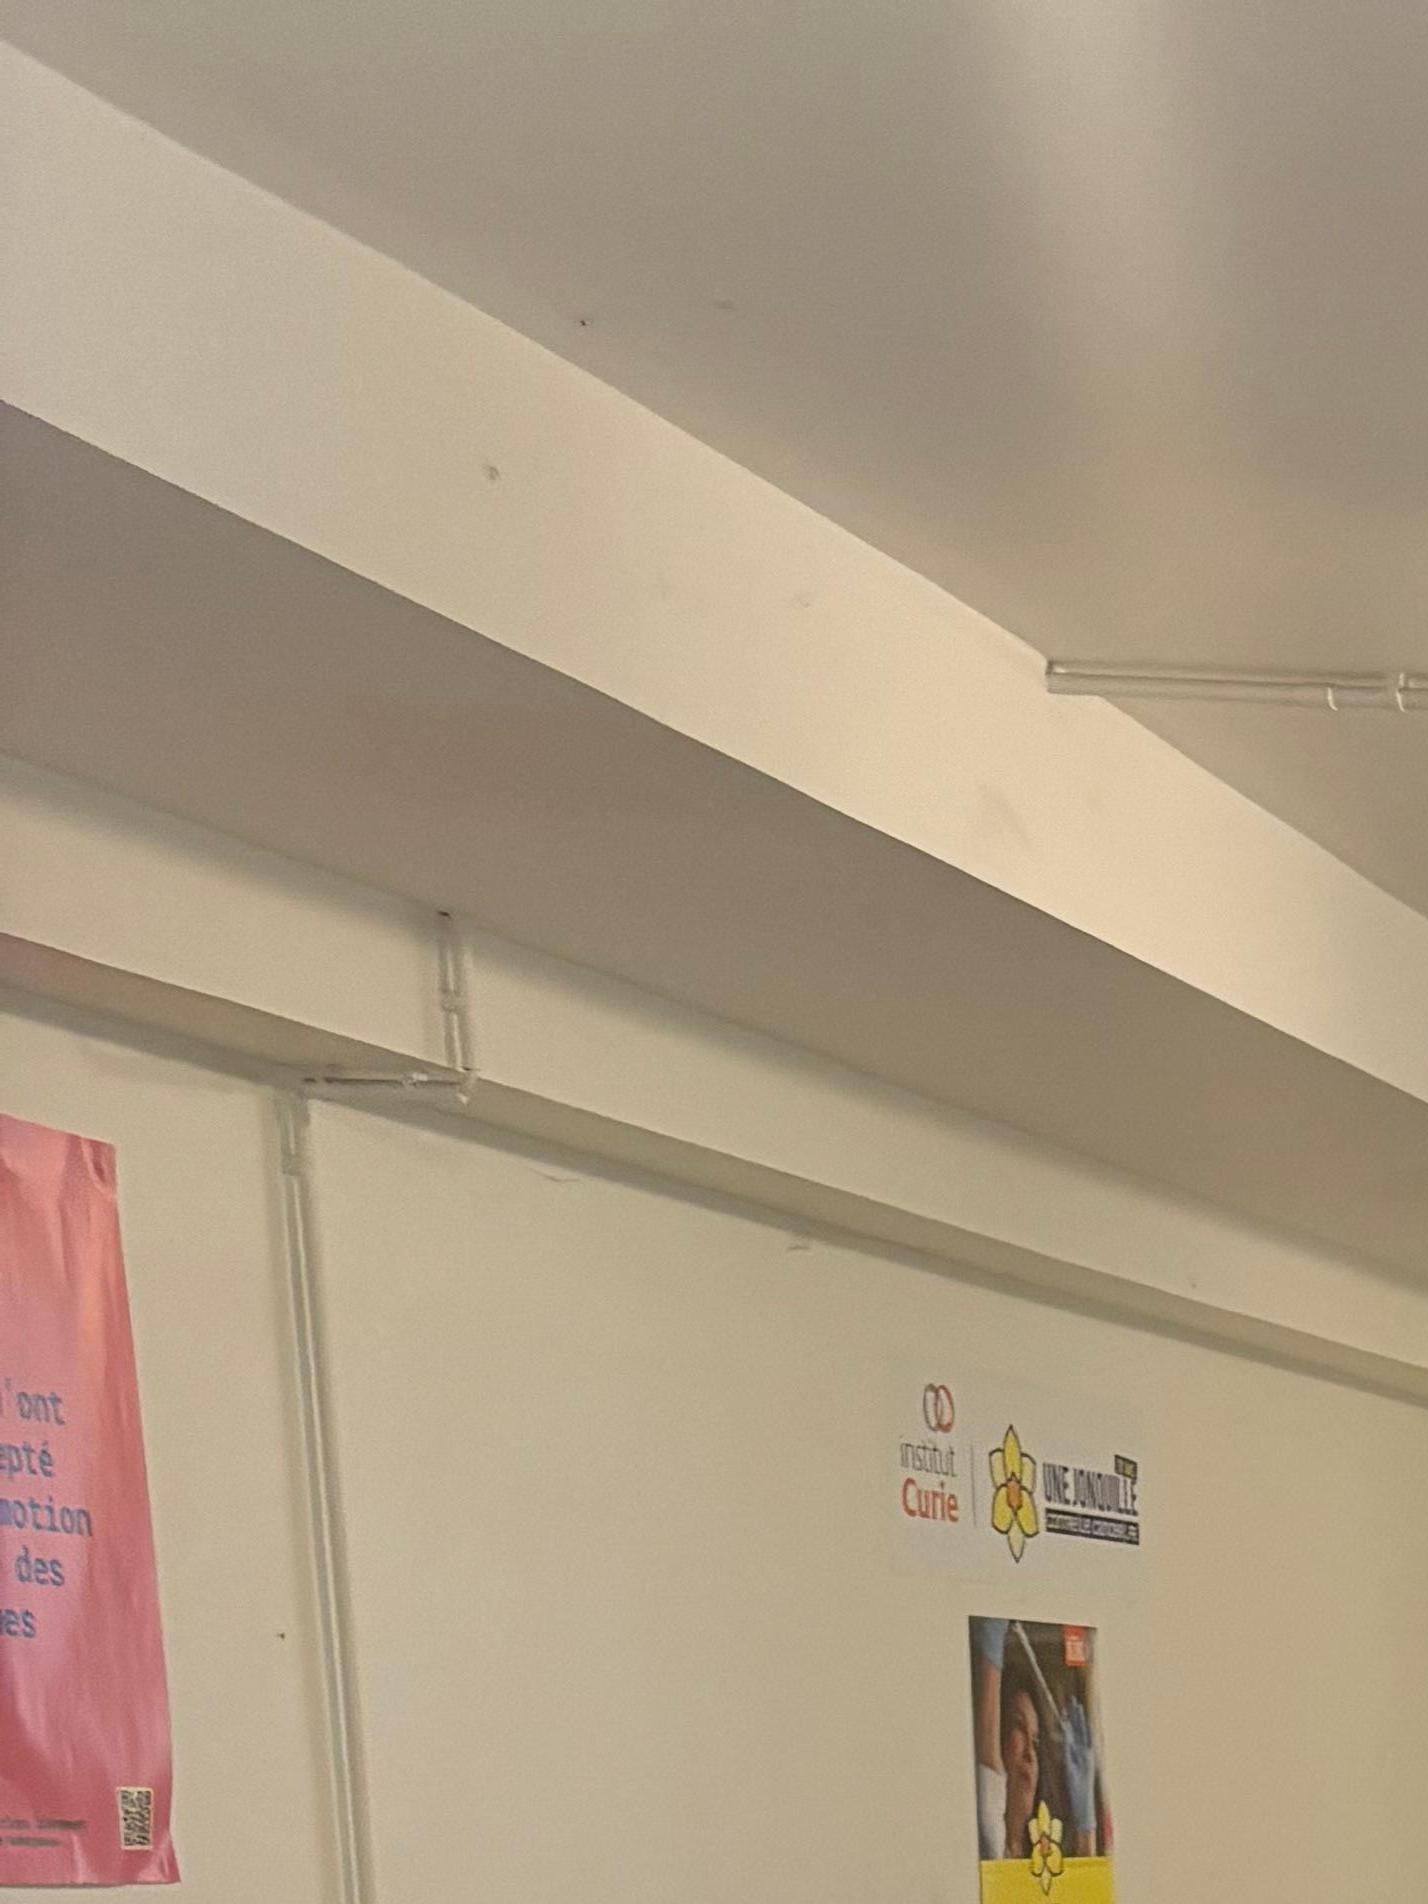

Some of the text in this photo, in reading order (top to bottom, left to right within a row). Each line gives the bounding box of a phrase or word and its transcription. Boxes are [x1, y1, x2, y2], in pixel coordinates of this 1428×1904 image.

[900, 1436, 957, 1477] institut
[902, 1477, 959, 1523] Curie
[15, 1545, 65, 1586] des
